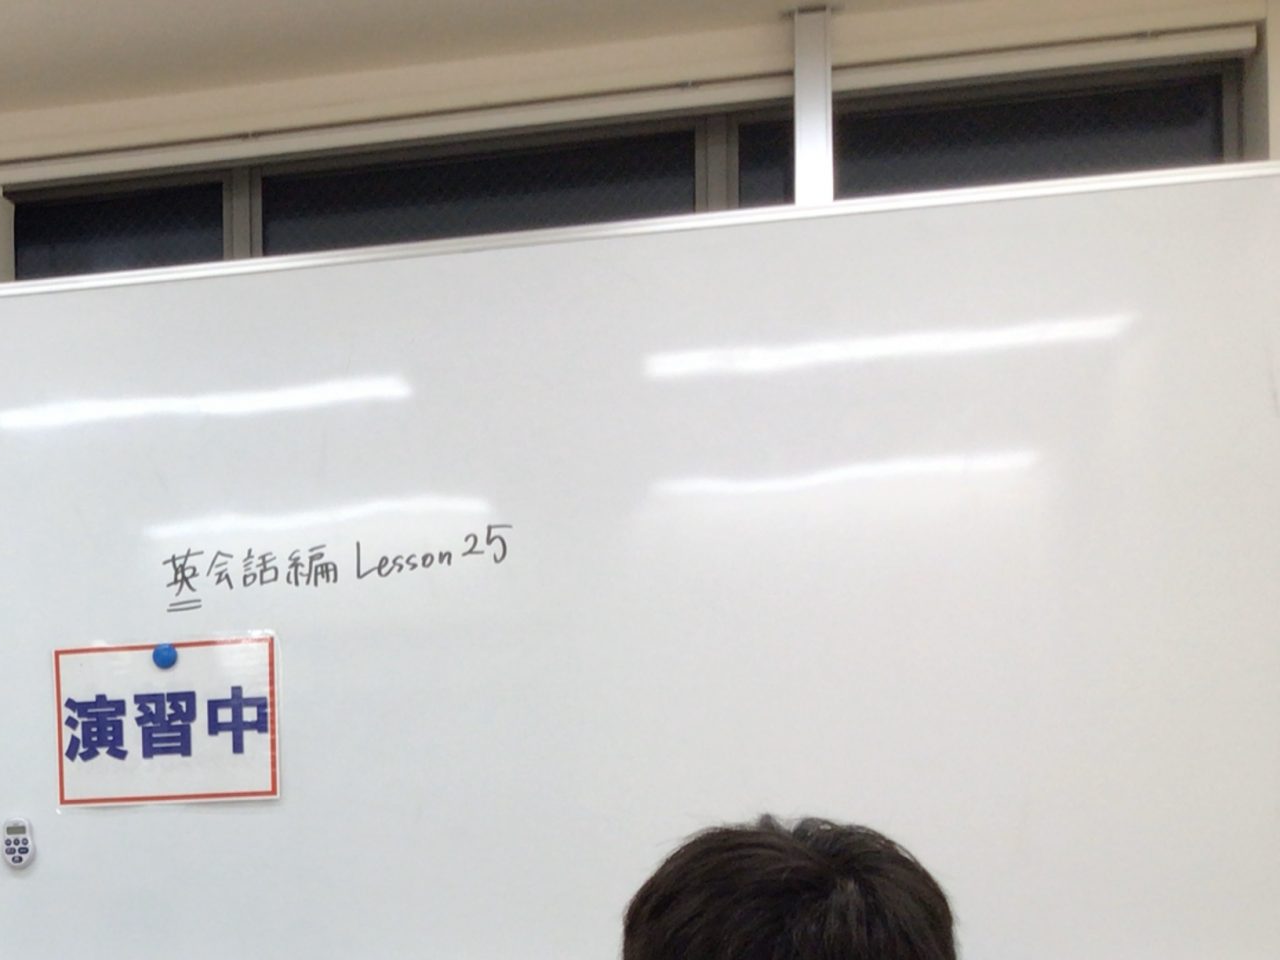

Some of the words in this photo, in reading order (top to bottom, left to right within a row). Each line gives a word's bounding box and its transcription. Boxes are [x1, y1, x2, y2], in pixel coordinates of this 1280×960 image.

[163, 546, 338, 597] 英会話編
[355, 541, 452, 580] Lesson
[462, 524, 513, 564] 25
[63, 685, 269, 763] 演習中
